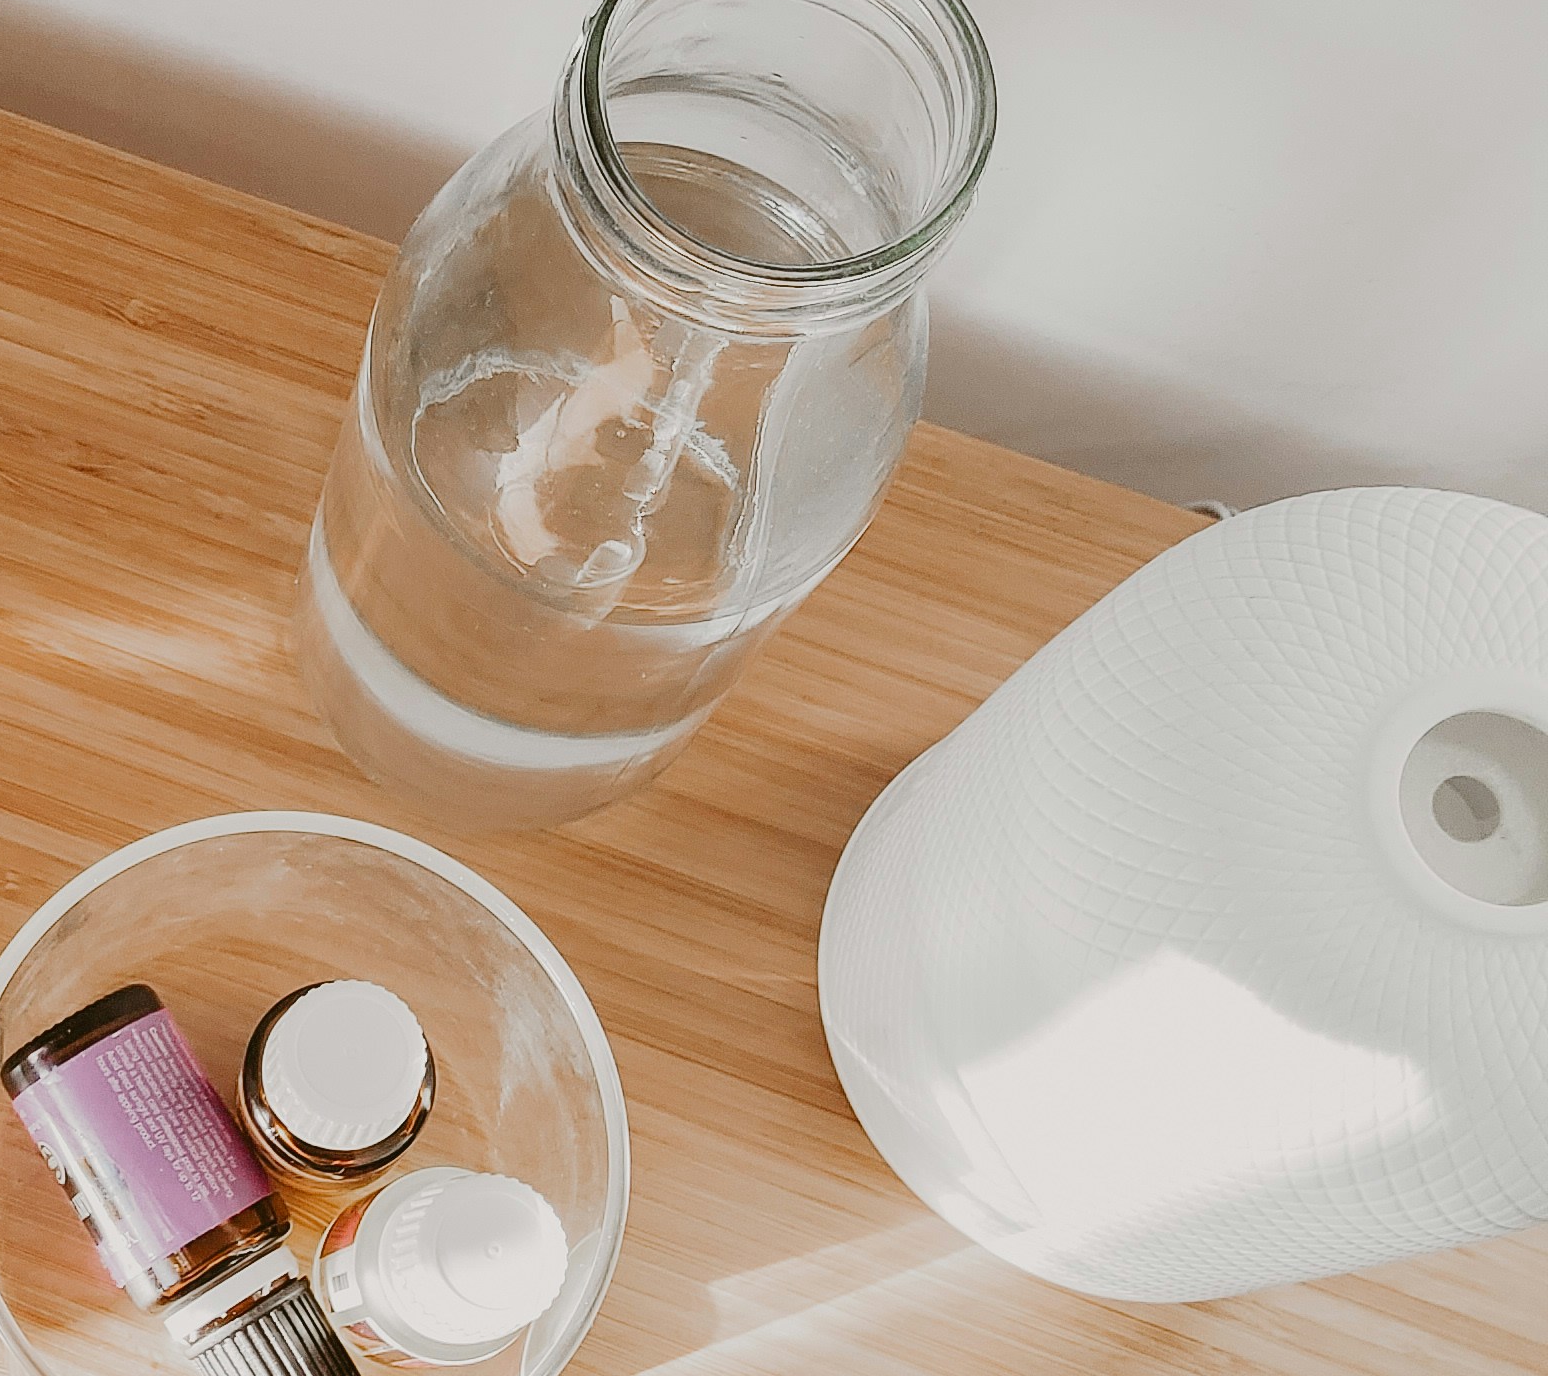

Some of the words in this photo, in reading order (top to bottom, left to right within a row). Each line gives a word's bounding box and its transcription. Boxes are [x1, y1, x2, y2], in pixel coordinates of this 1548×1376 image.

[95, 1054, 112, 1077] hours
[107, 1076, 122, 1093] after
[117, 1093, 139, 1124] applying
[105, 1050, 123, 1071] Avoid
[117, 1070, 134, 1091] direct
[129, 1090, 150, 1118] sunlight
[145, 1117, 160, 1132] and
[162, 1144, 175, 1161] rays
[223, 1167, 237, 1182] and
